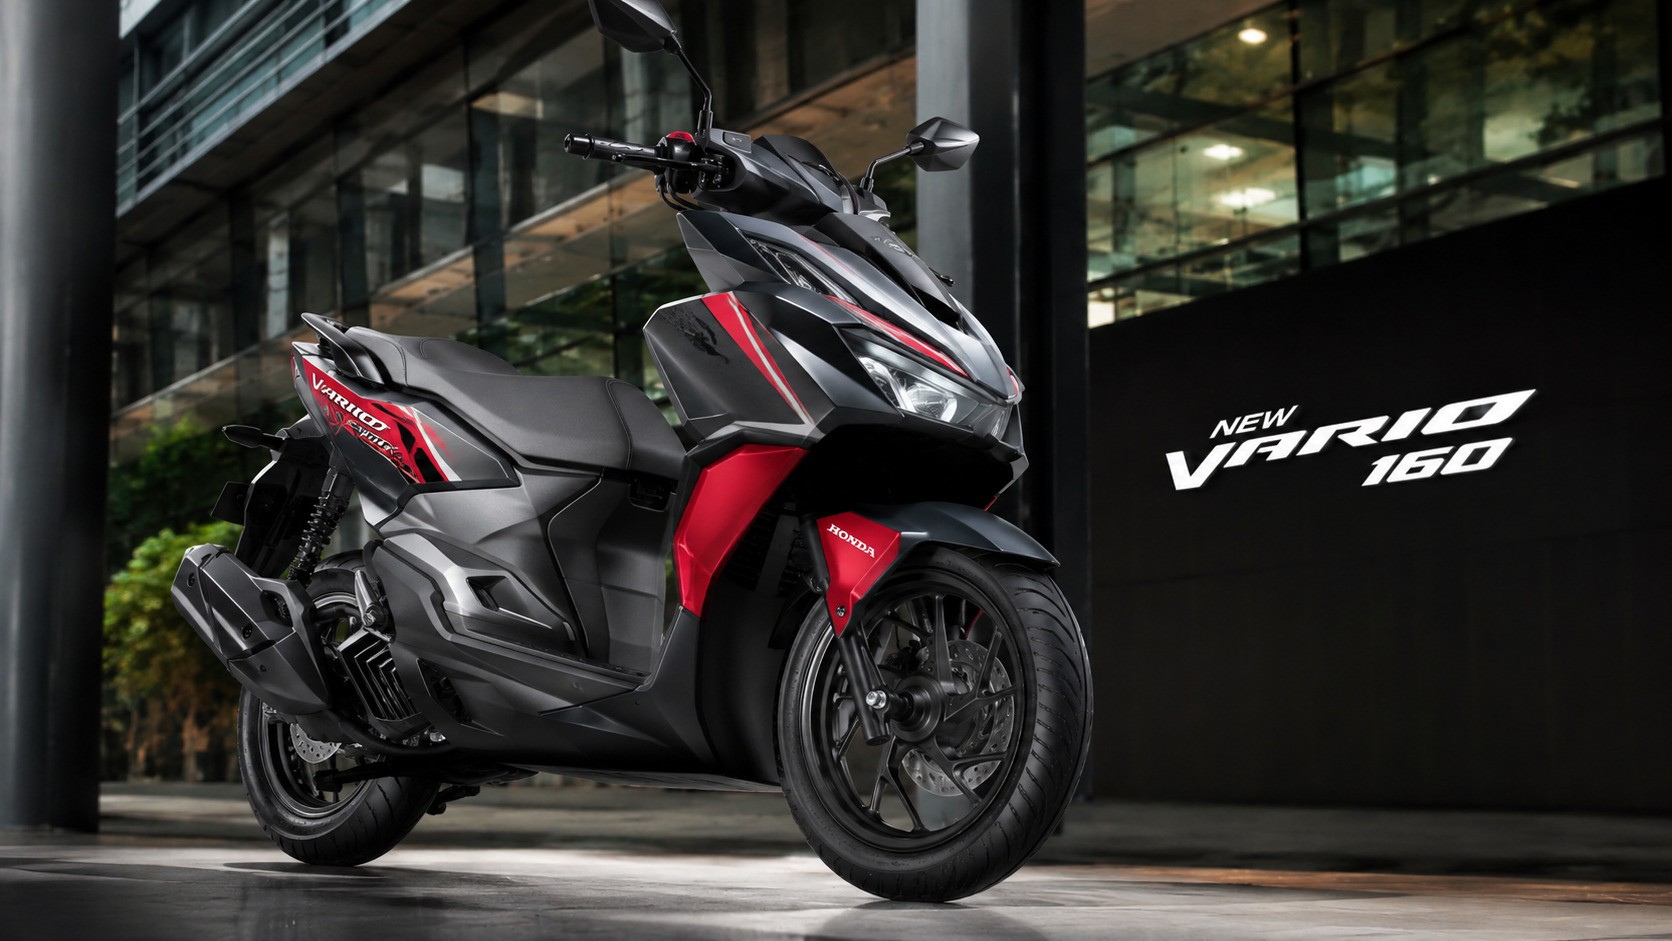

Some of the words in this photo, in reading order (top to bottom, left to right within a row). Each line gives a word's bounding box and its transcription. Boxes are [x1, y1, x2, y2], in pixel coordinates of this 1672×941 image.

[1166, 389, 1536, 490] VARIO
[1210, 405, 1298, 438] NEW
[1362, 437, 1513, 486] 160
[827, 524, 875, 558] HONDA
